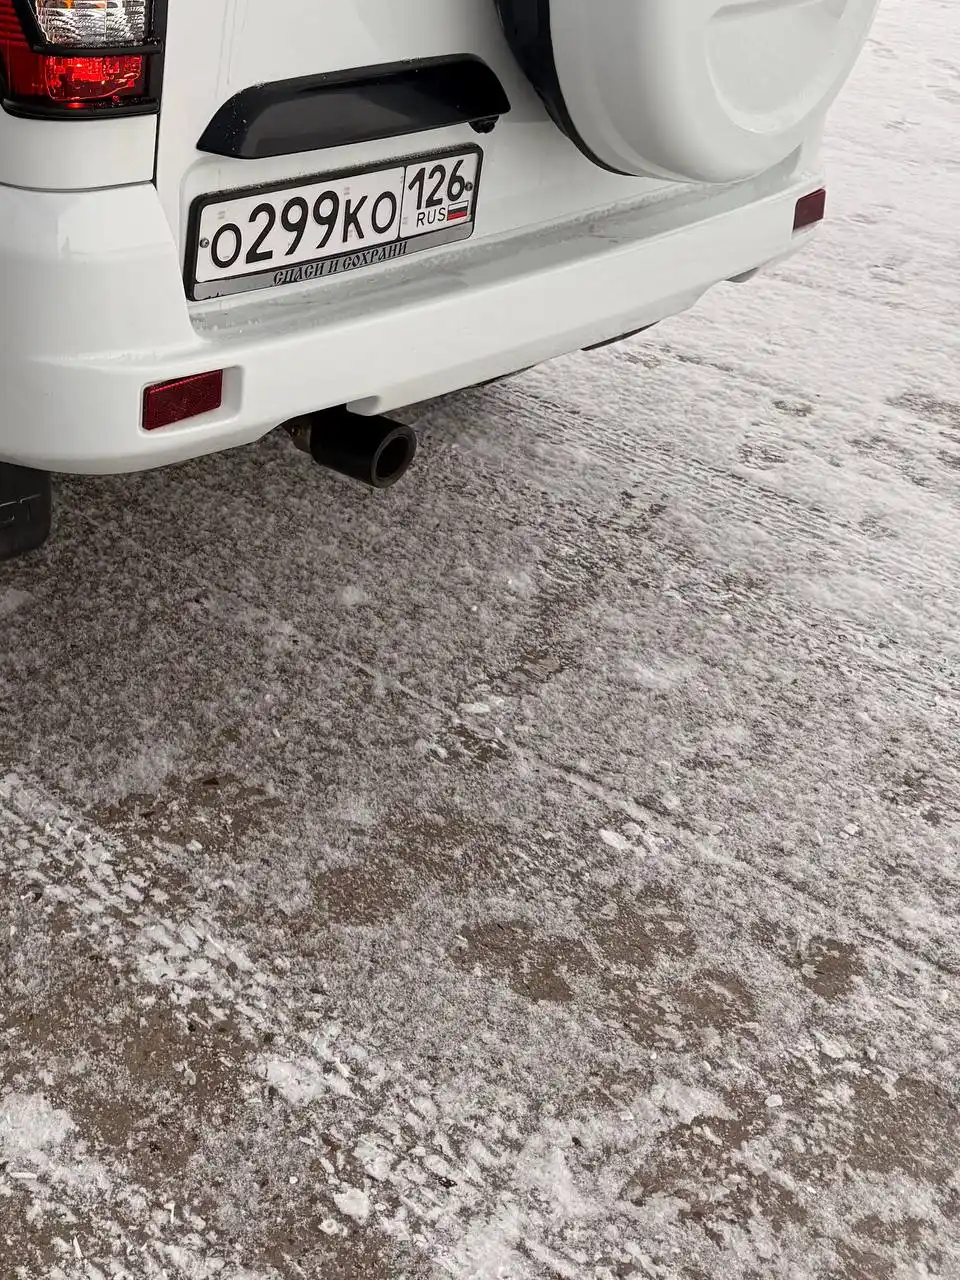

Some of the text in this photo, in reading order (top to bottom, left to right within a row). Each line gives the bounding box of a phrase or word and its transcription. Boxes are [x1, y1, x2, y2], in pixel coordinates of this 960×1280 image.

[408, 159, 466, 210] 126
[416, 207, 446, 227] RUS
[274, 241, 409, 285] СПАСИ И СОХРАНИ
